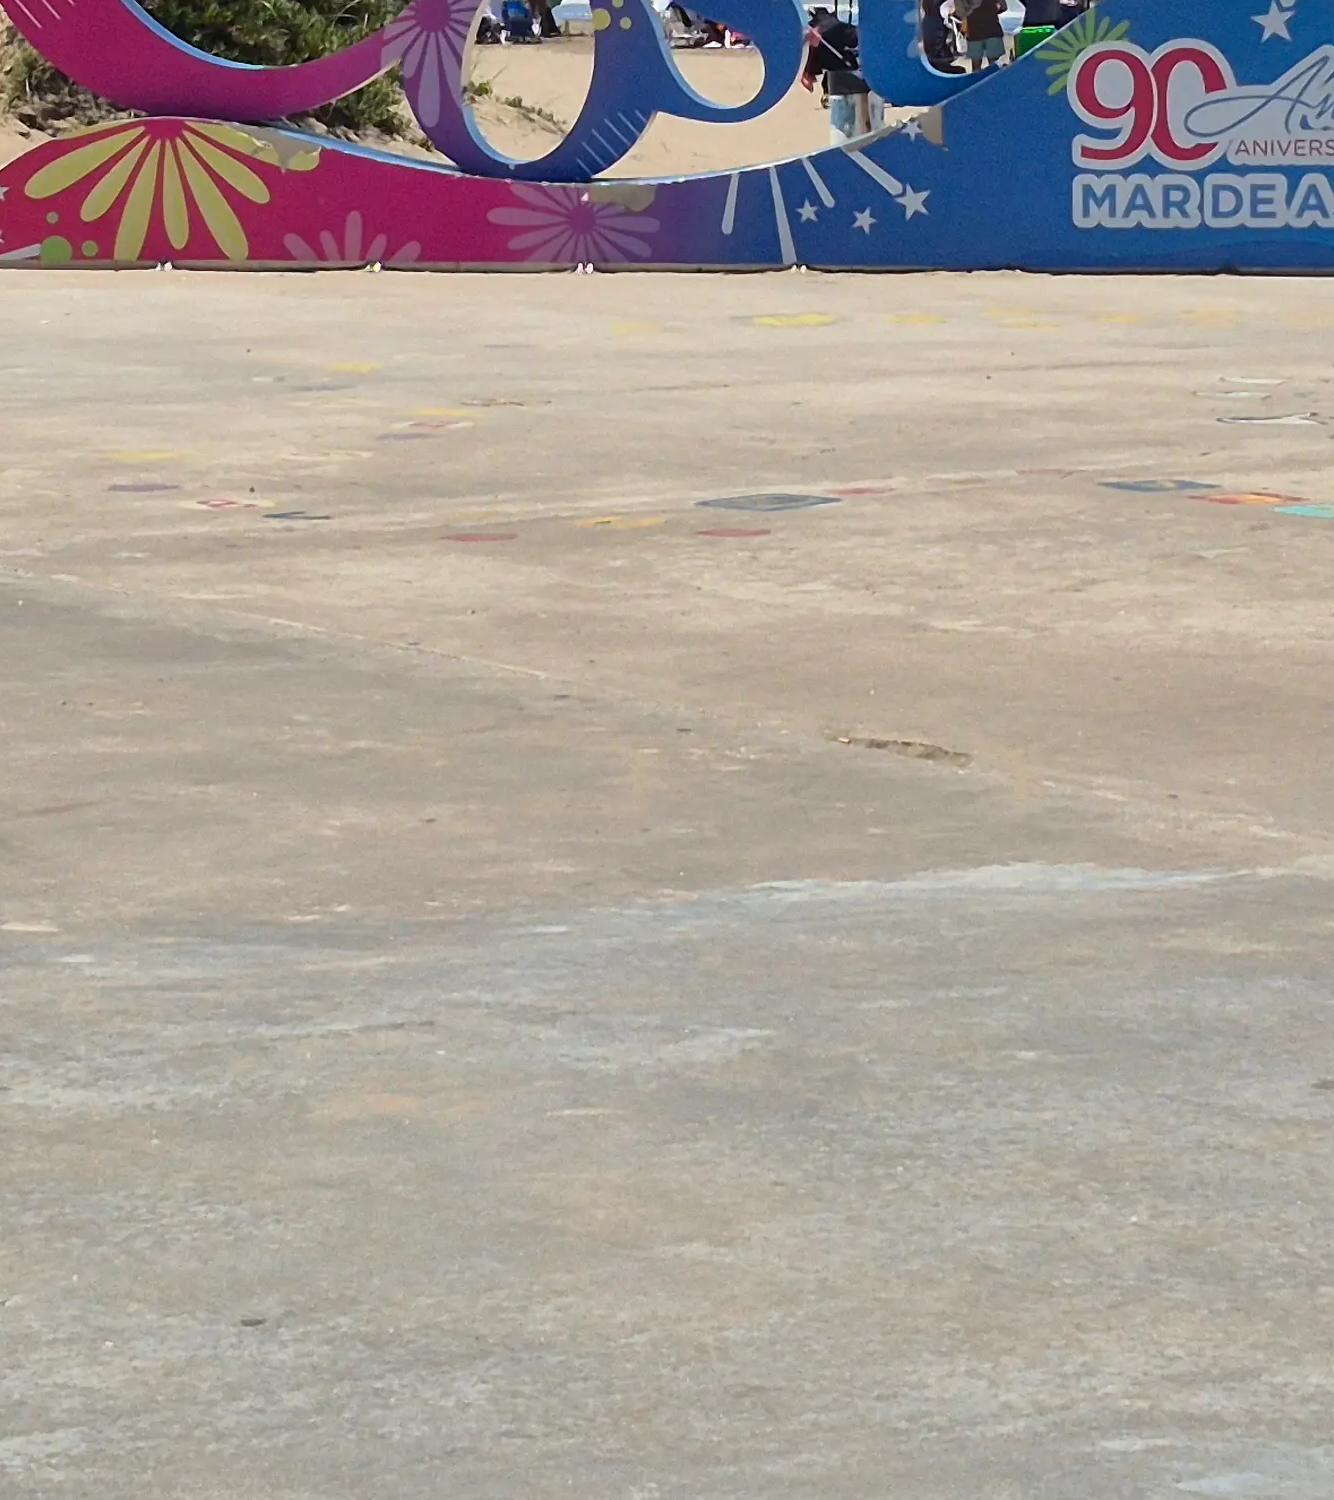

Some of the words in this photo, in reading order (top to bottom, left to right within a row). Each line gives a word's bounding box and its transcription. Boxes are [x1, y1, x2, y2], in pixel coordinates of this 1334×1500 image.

[1075, 47, 1228, 161] 90
[1081, 183, 1192, 219] MAR
[1210, 184, 1279, 219] DE
